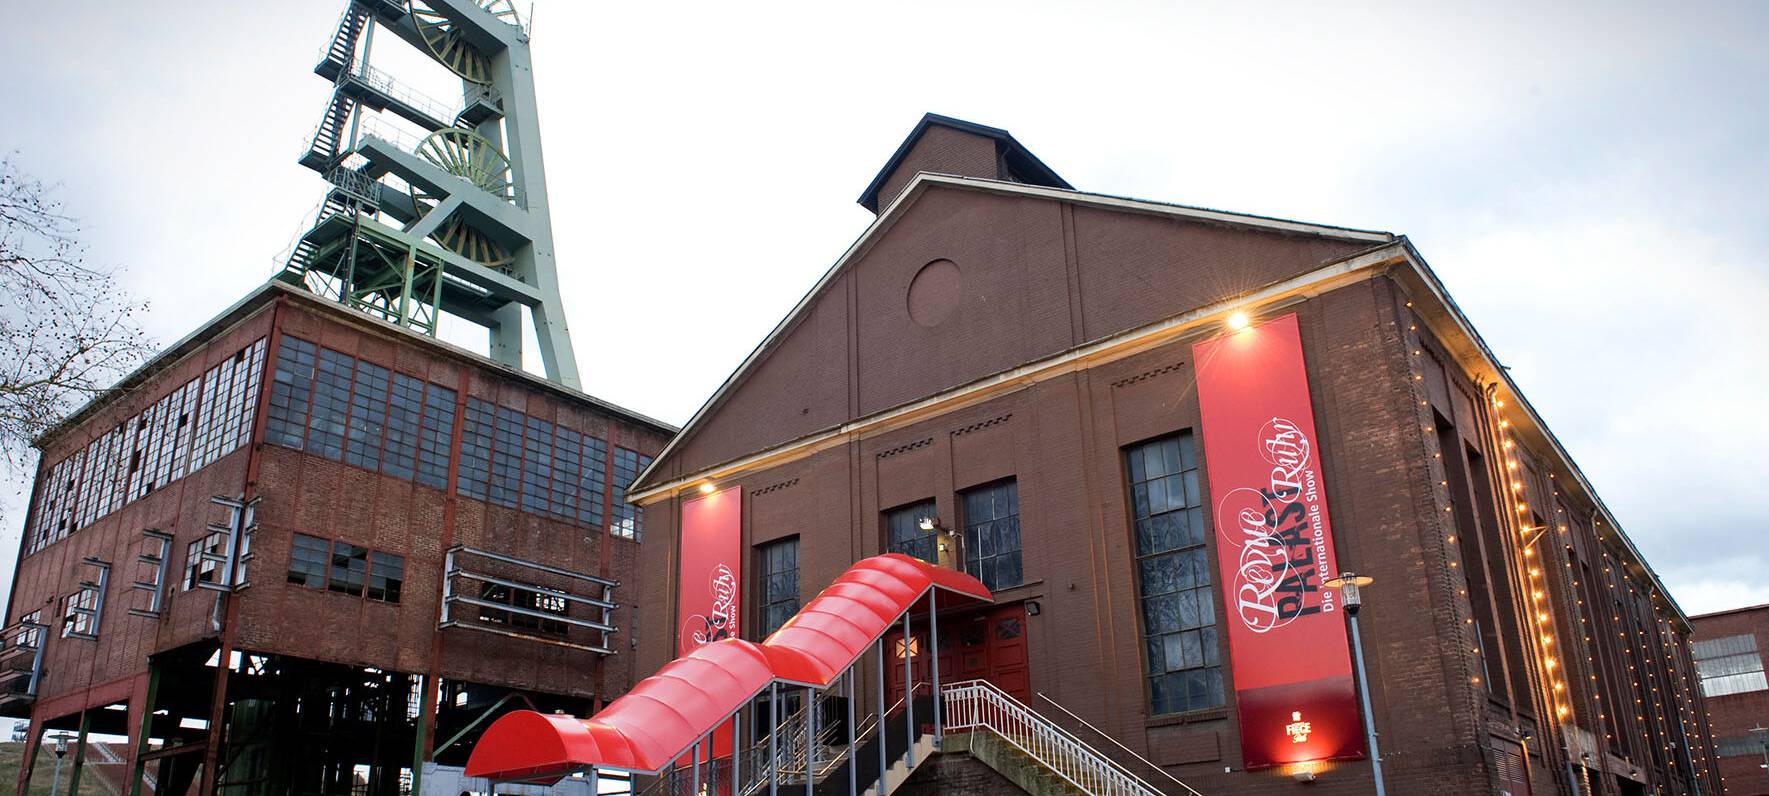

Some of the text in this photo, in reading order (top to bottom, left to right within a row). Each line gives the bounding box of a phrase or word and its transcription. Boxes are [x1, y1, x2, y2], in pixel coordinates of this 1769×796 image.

[1259, 417, 1311, 503] Ruhr
[1305, 470, 1335, 613] Die nternationale Show
